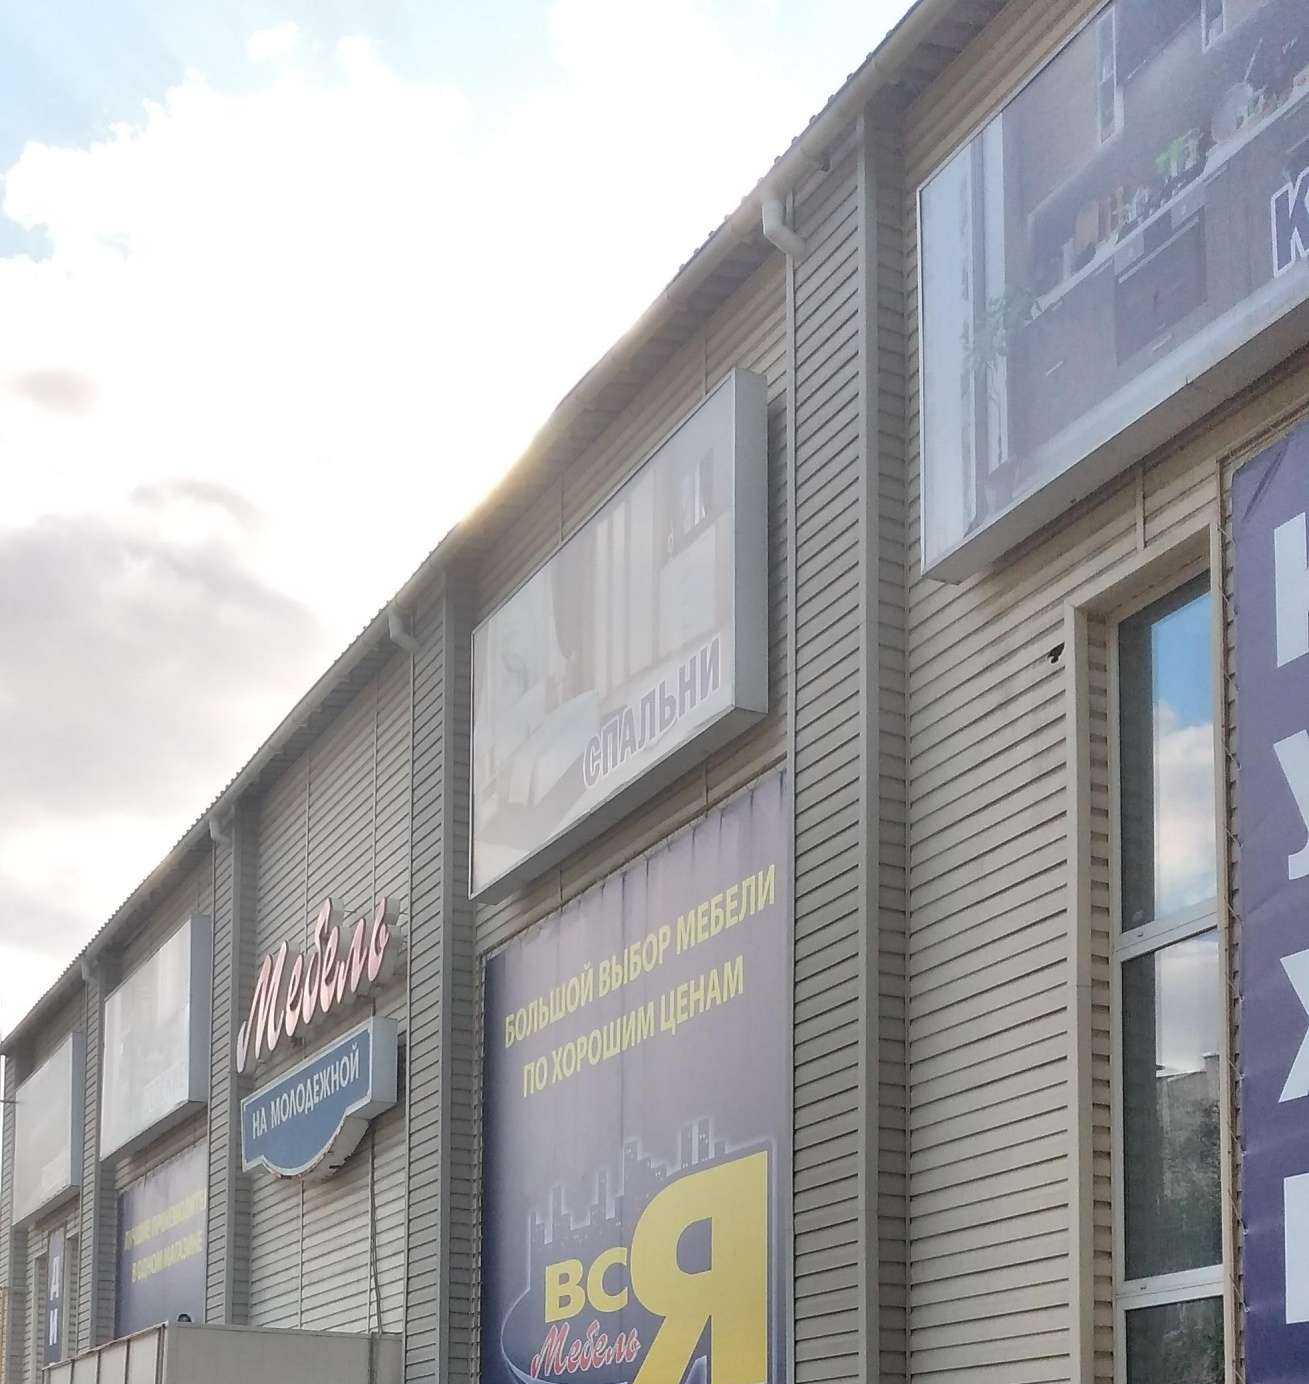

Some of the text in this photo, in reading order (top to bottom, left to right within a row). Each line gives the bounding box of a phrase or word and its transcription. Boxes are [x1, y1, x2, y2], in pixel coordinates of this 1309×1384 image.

[582, 632, 722, 790] СПАЛЬНИ
[236, 897, 390, 1073] Мебель
[505, 863, 776, 1048] БОЛЬШОЙ ВЫБОР МЕБЕЛИ
[522, 955, 744, 1098] ПО ХОРОШИМ ЦЕНАМ
[252, 1042, 360, 1140] НА МОЛОДЕЖНОЙ
[530, 1320, 642, 1379] Мебель
